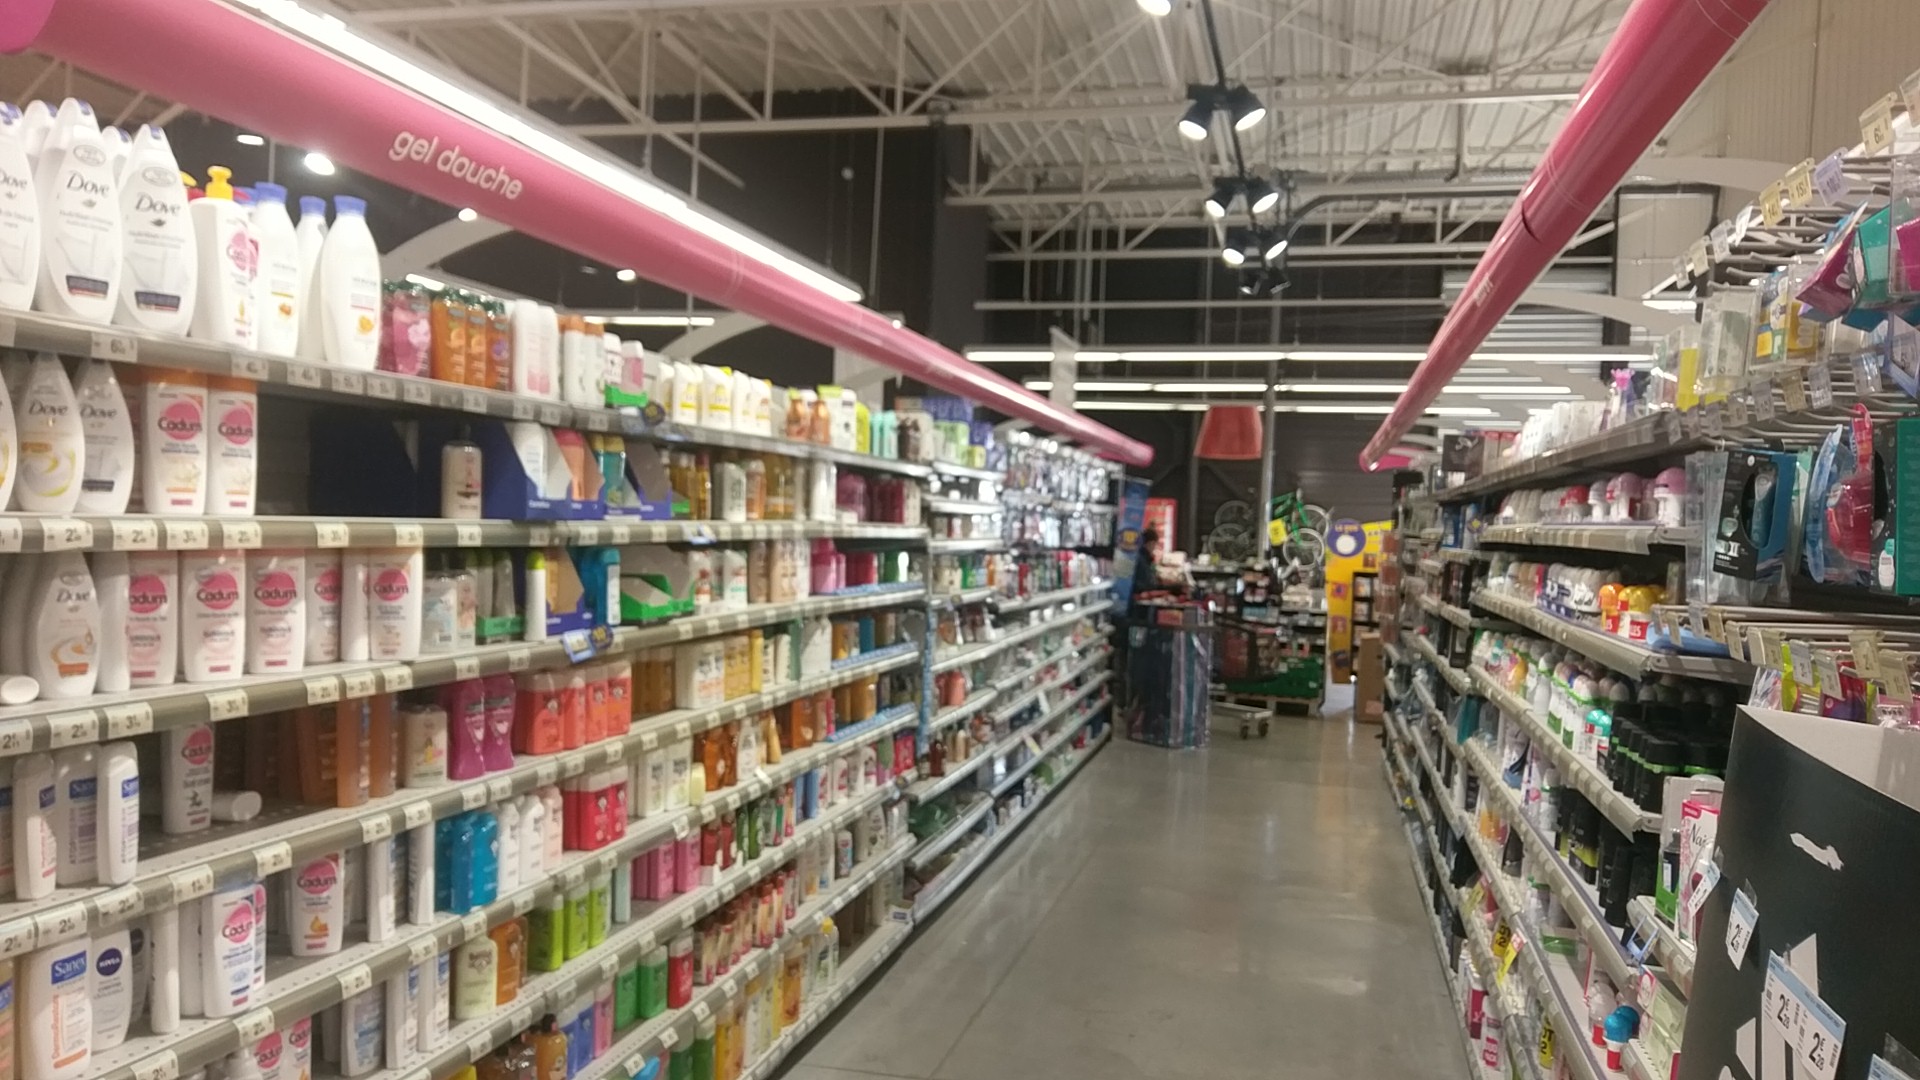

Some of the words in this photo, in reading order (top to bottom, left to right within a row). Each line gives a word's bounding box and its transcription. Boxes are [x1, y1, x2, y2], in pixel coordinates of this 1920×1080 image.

[388, 130, 439, 164] gel
[436, 145, 523, 200] douche
[66, 169, 110, 196] Dove
[134, 191, 181, 215] Dove
[28, 399, 68, 416] Dove
[79, 403, 118, 419] Dove
[56, 587, 91, 603] Dove
[196, 588, 240, 604] Cadum
[254, 585, 298, 601] Cadum
[296, 876, 338, 890] Cadum
[54, 957, 86, 978] Sanex
